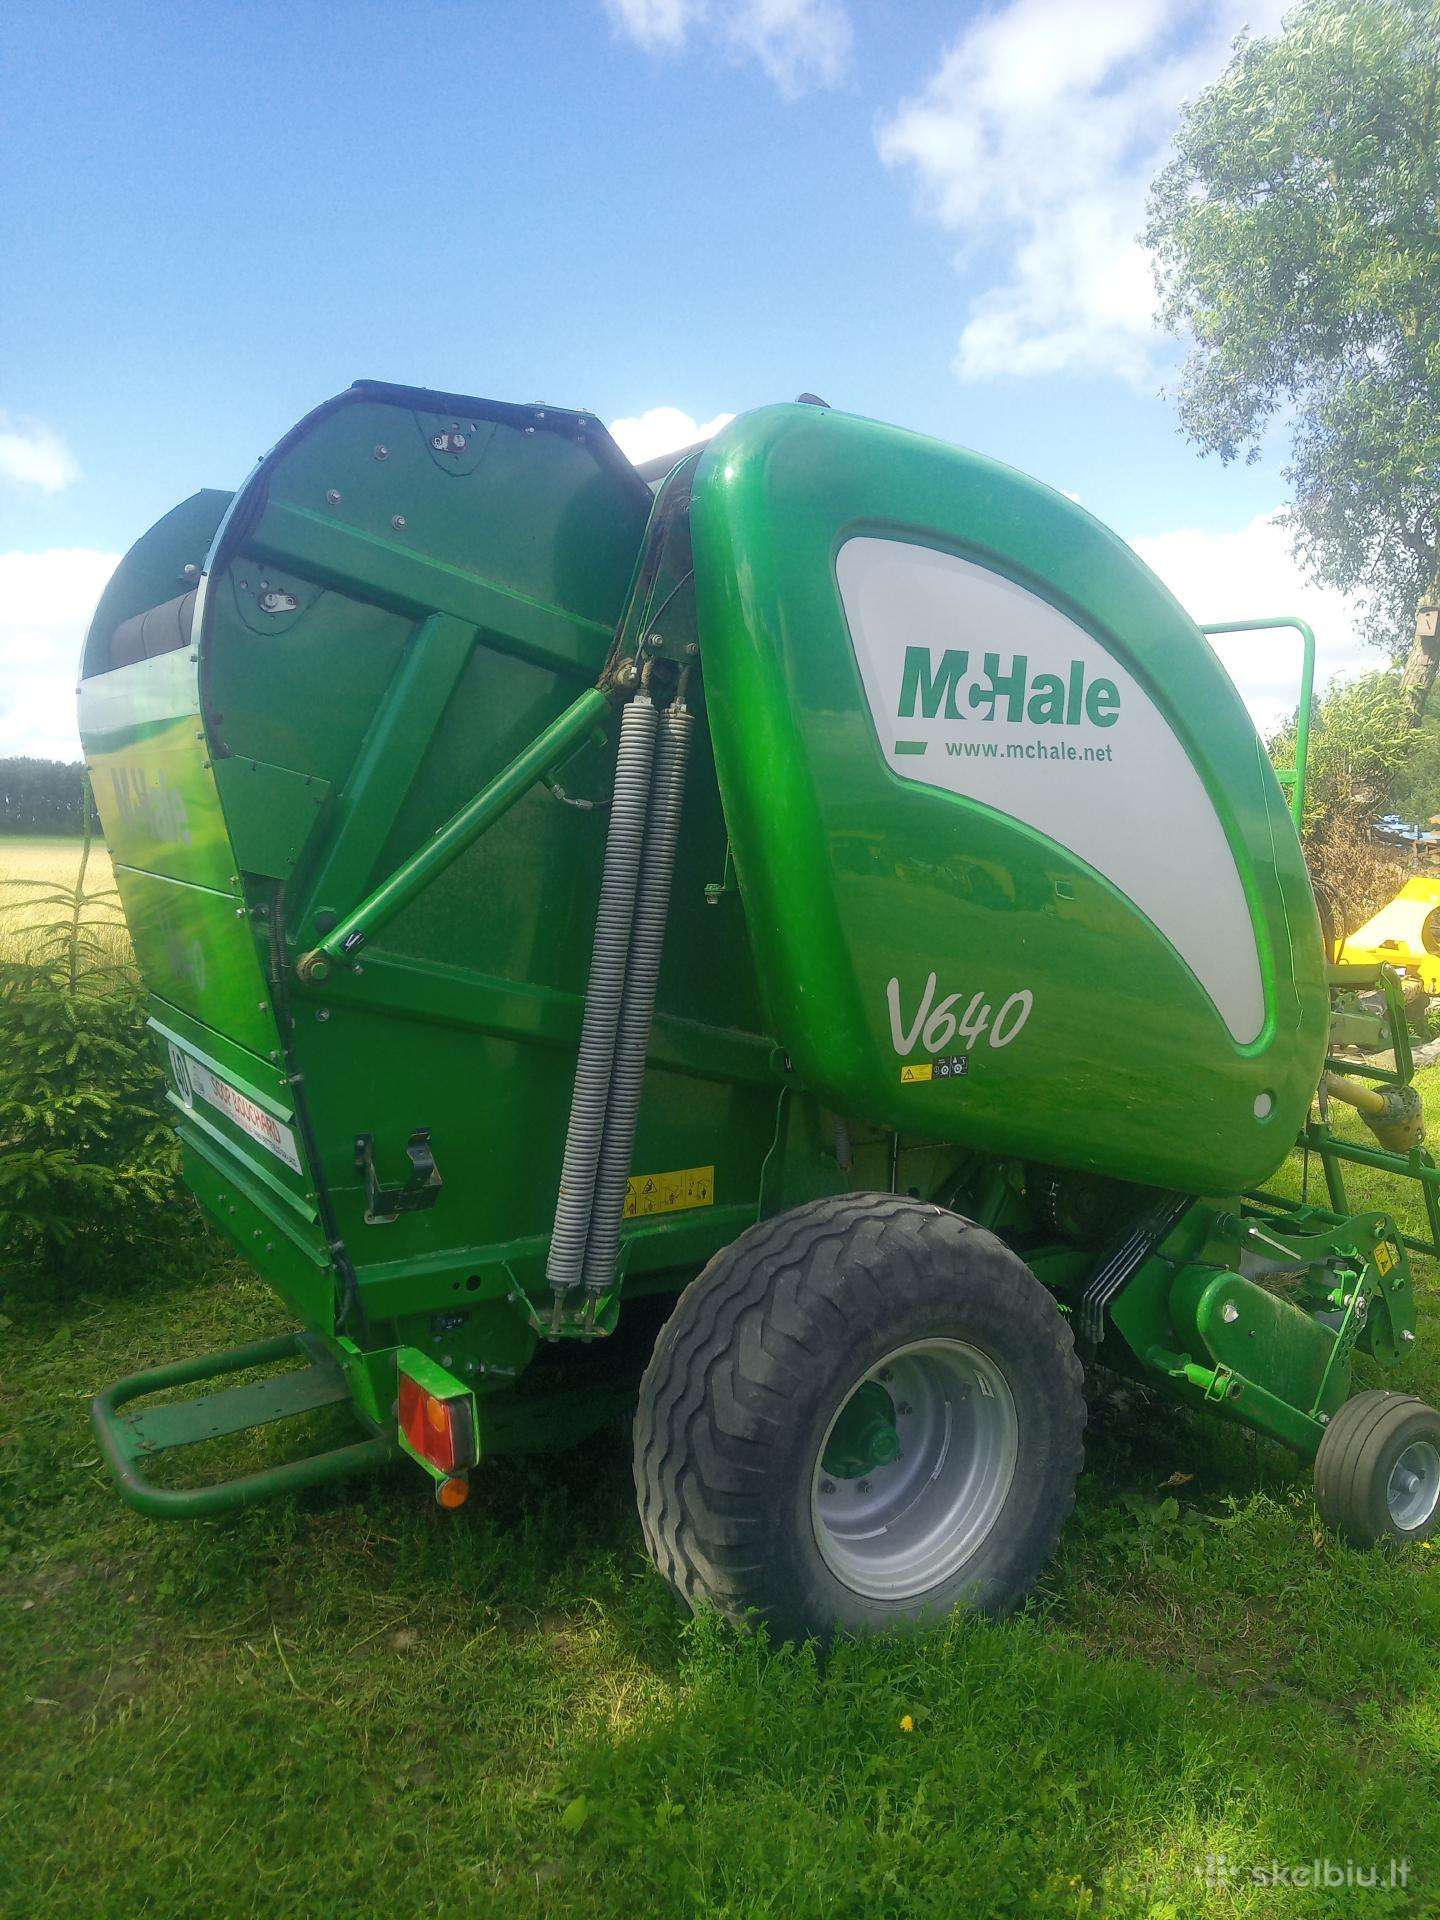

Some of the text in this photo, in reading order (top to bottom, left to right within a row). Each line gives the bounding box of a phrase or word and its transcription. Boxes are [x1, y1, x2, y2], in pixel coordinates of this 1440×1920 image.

[897, 645, 1121, 728] McHale
[945, 740, 1113, 763] www.mchale.net
[886, 971, 1034, 1056] V640
